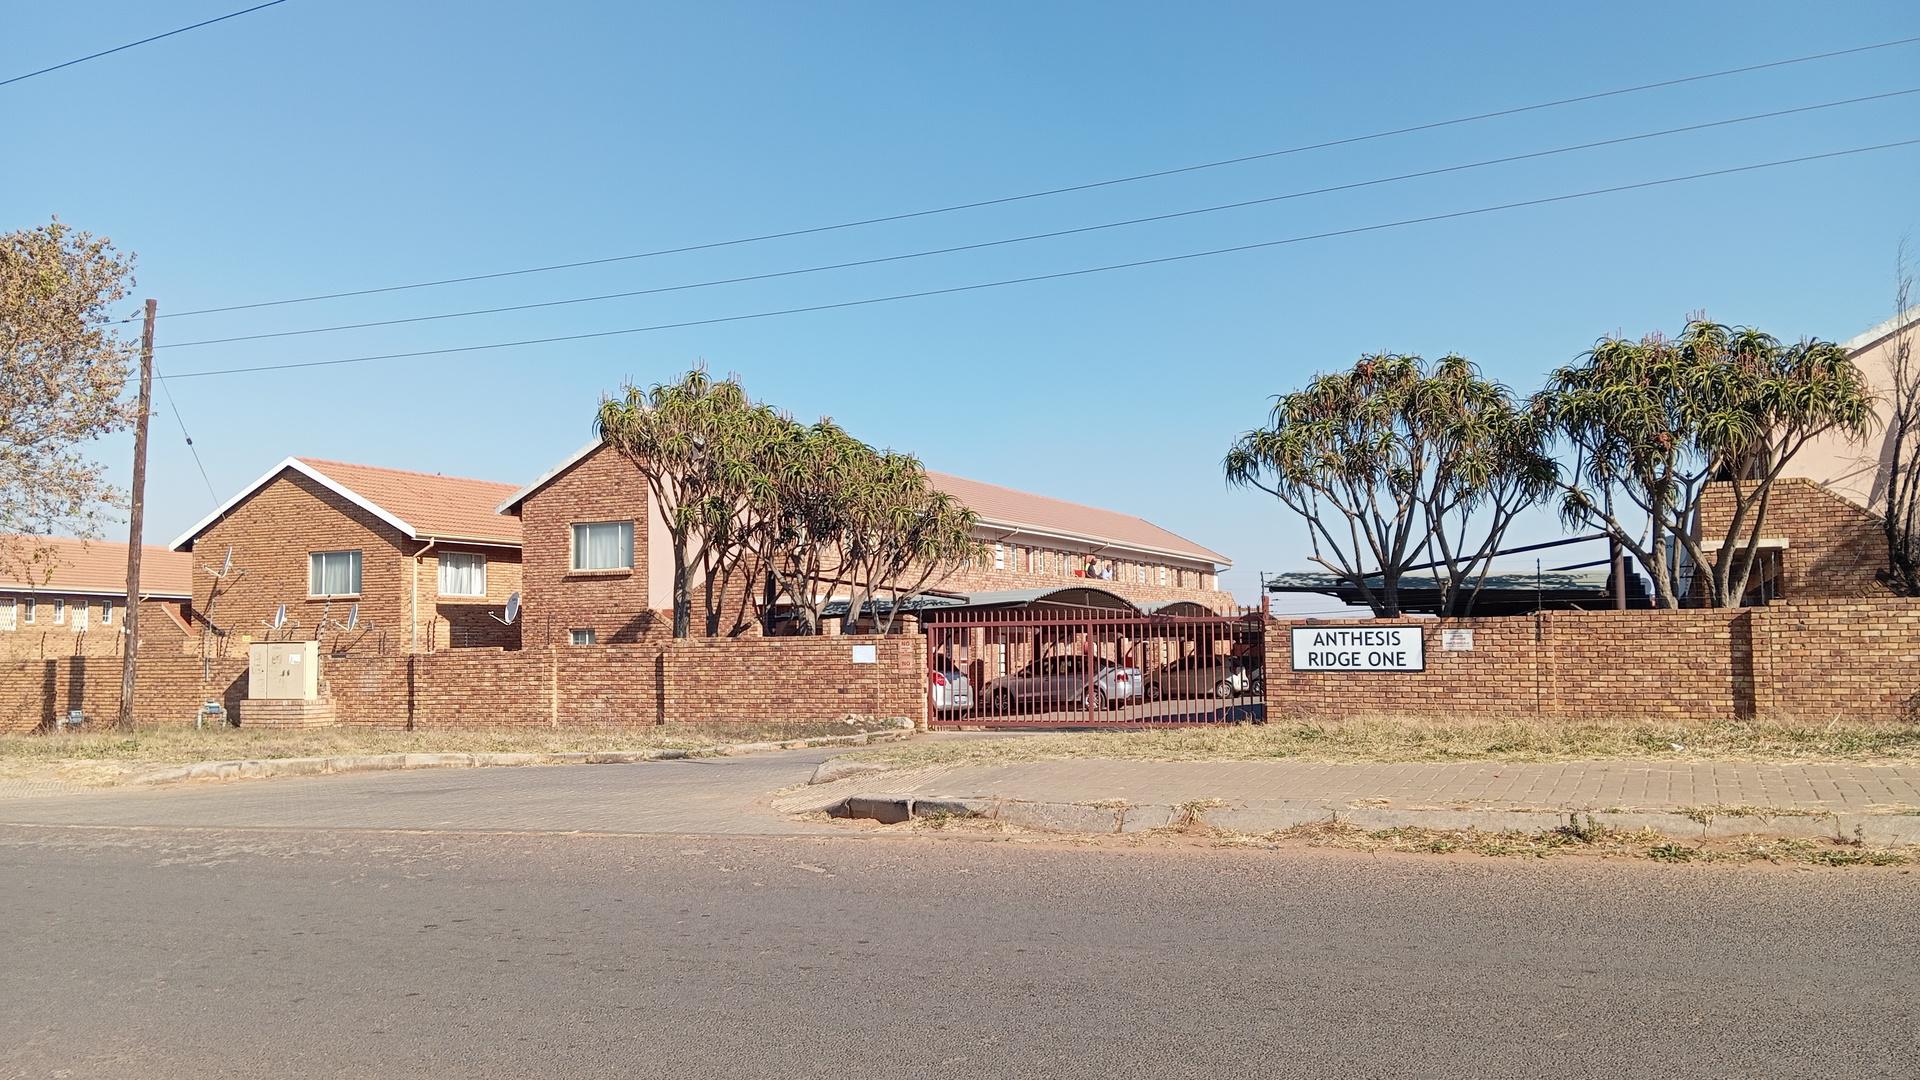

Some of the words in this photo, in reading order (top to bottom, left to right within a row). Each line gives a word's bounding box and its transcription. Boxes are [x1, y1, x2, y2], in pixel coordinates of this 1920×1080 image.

[1313, 631, 1401, 647] ANTHESIS
[1308, 651, 1362, 667] RIDGE
[1368, 651, 1407, 667] ONE
